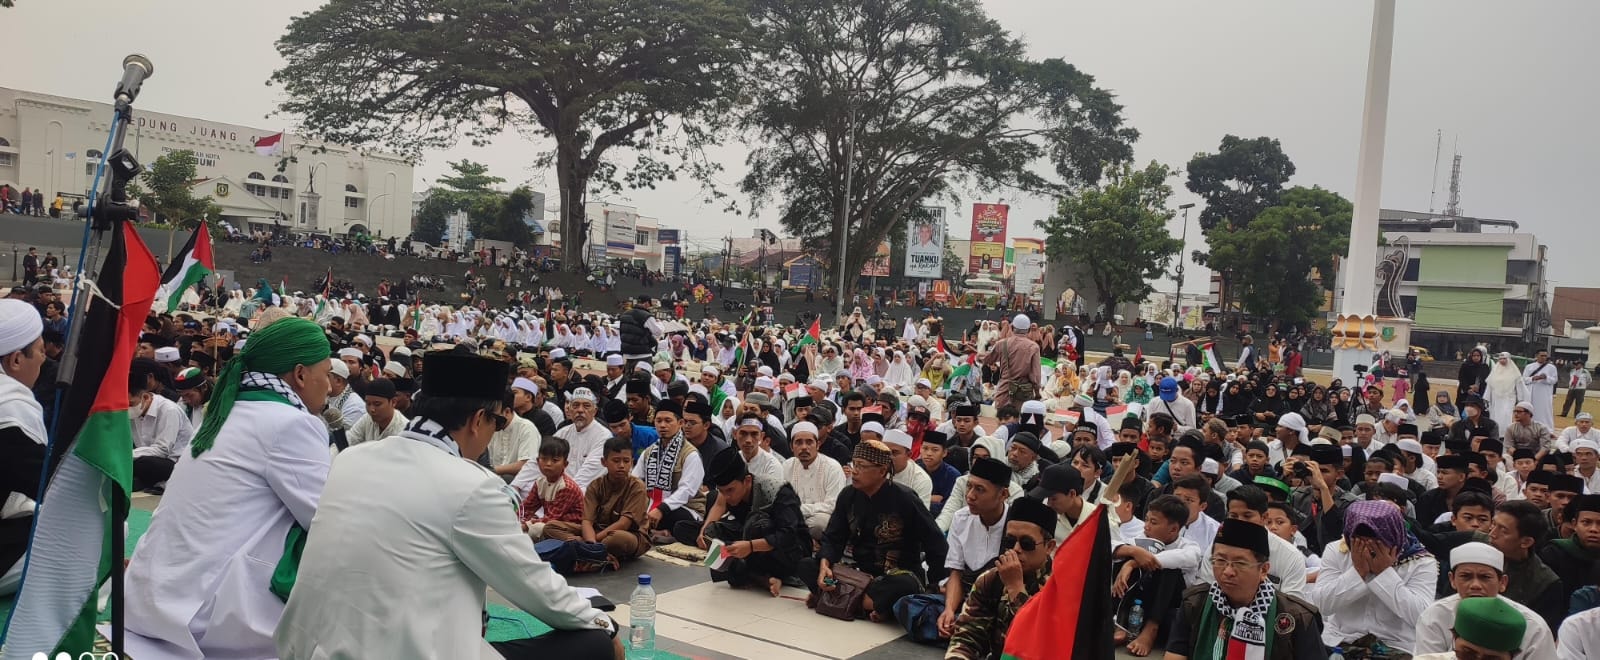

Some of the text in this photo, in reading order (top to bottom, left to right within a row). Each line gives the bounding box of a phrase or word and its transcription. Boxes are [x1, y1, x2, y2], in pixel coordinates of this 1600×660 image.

[130, 117, 177, 132] EDUNG
[190, 125, 237, 141] JUANG
[911, 254, 939, 264] TUANKU
[659, 462, 672, 486] SAVE
